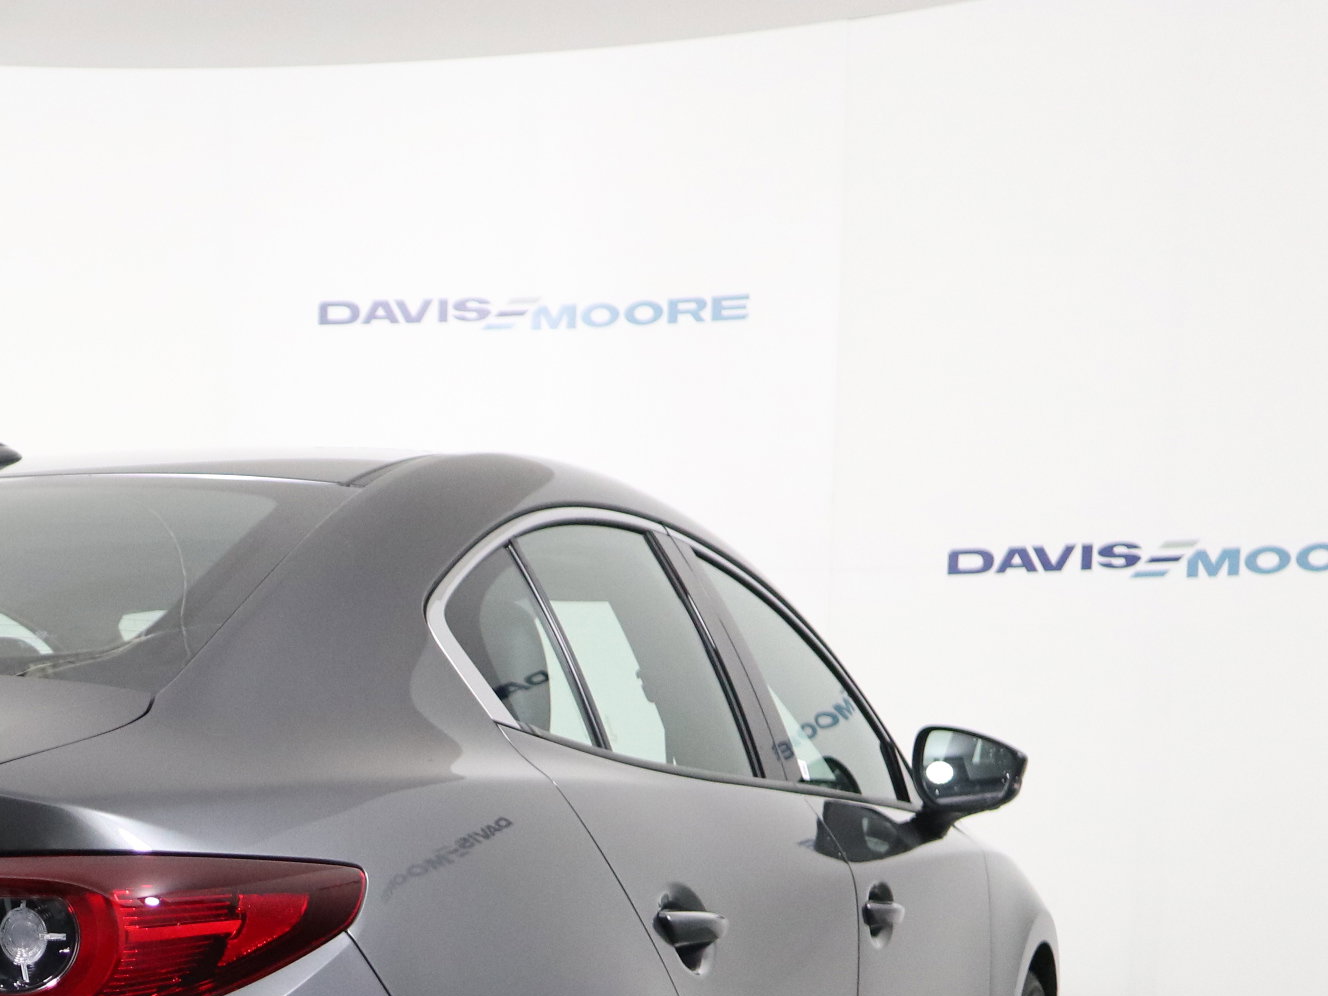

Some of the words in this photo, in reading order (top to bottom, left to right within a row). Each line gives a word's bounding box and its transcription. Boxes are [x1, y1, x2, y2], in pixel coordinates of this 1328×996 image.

[317, 297, 492, 326] DAVIS
[530, 294, 750, 331] MOORE
[947, 541, 1142, 576] DAVIS
